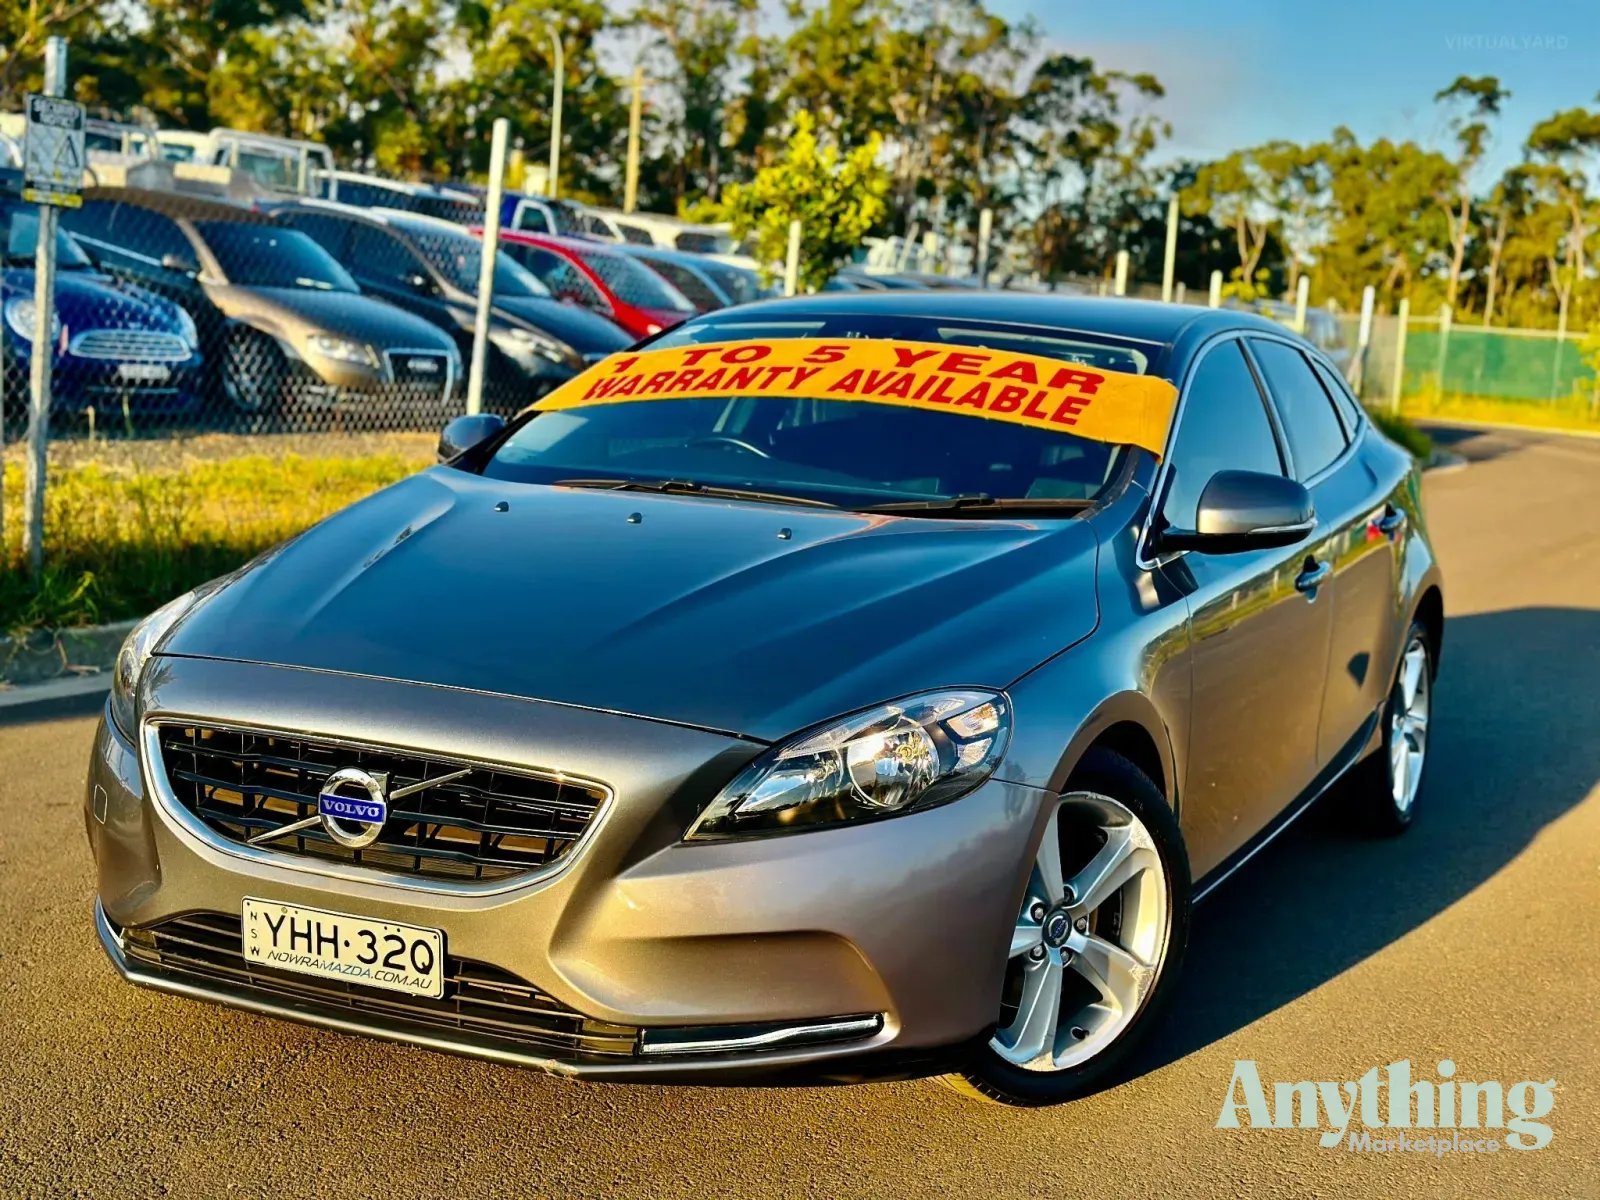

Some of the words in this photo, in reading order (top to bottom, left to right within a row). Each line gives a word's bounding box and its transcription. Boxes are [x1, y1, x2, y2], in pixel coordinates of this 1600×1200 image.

[614, 356, 640, 373] 1
[681, 345, 772, 366] TO
[803, 345, 850, 363] 5
[893, 347, 1105, 395] YEAR
[581, 366, 824, 400] WARRANTY
[827, 368, 1091, 426] AVAILABLE
[323, 799, 380, 817] VOLVO
